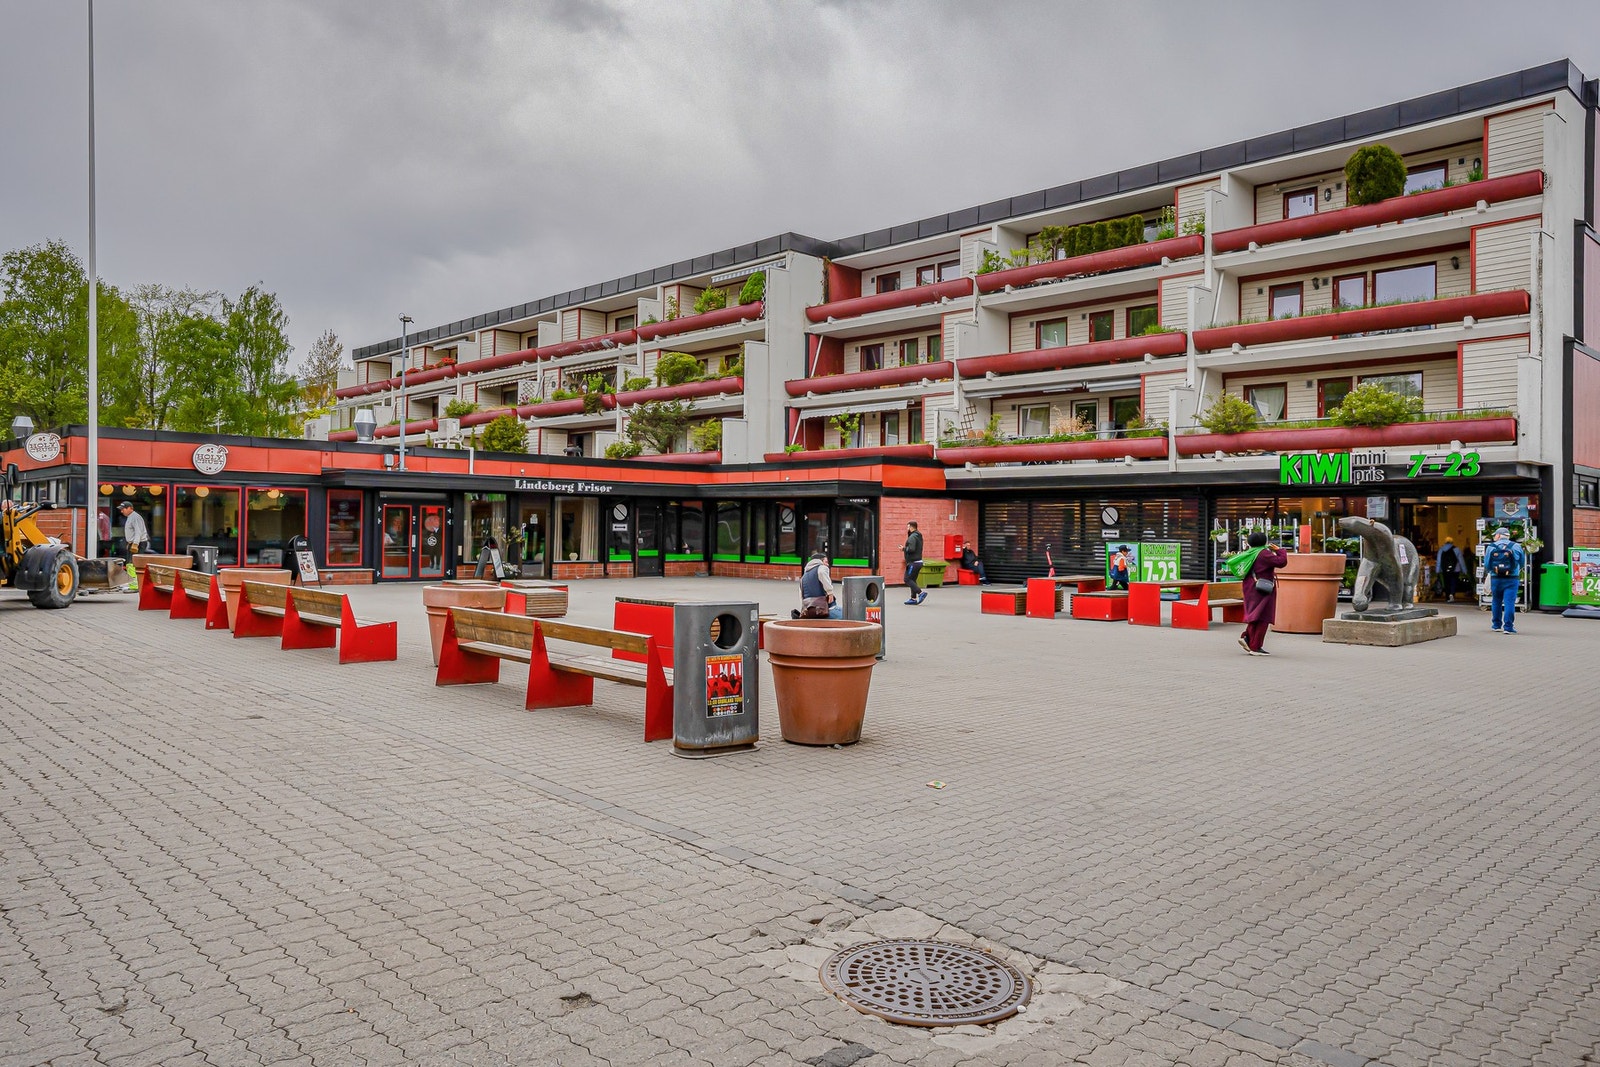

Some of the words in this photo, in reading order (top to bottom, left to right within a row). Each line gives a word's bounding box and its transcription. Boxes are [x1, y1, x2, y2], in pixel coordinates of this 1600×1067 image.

[1354, 449, 1388, 465] mini
[1280, 452, 1352, 485] KIWI
[1354, 466, 1386, 485] pris
[514, 479, 575, 494] Lindeberg
[577, 482, 613, 494] Frisør
[1144, 543, 1167, 555] KIWI
